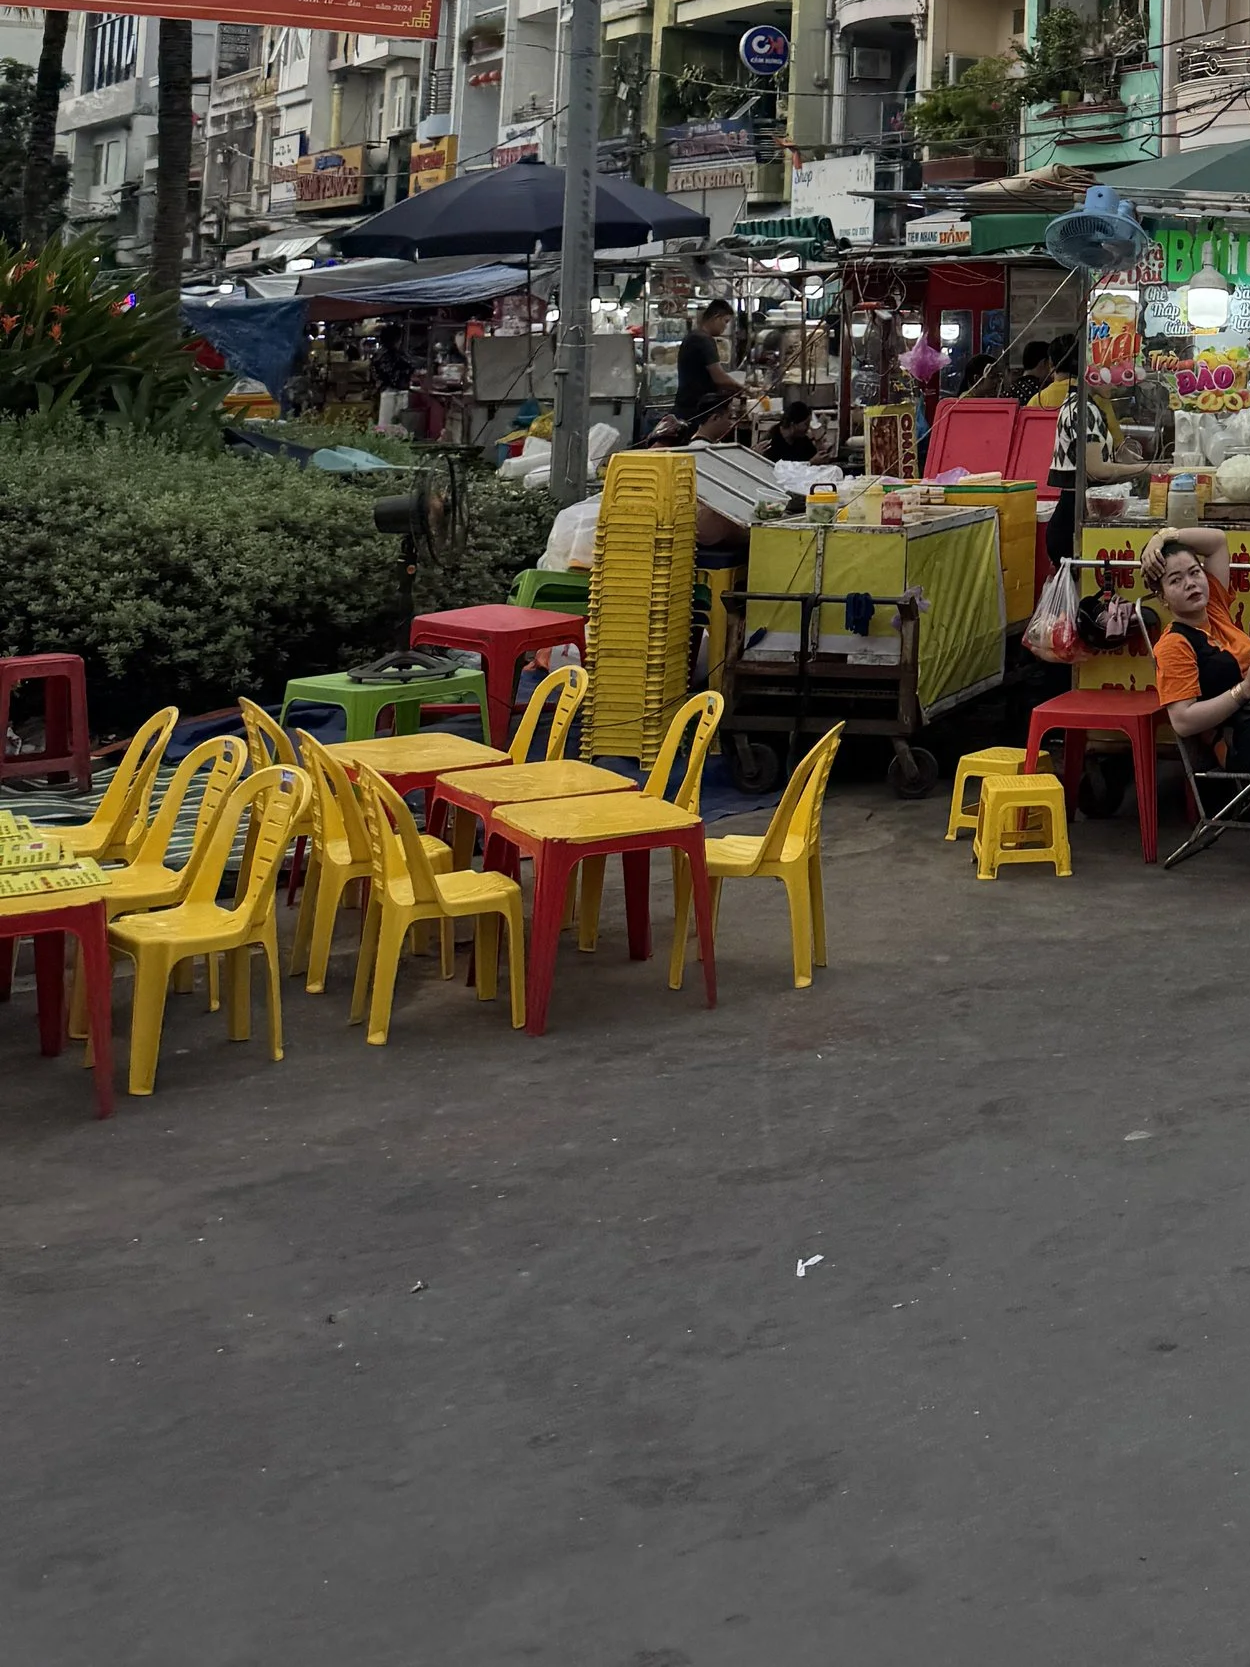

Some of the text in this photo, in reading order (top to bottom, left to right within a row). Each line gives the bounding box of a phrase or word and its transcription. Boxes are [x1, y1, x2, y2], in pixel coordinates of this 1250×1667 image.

[392, 4, 413, 13] 2024
[1152, 303, 1180, 321] Thập
[1091, 326, 1142, 366] VẢI
[1149, 349, 1180, 372] Trà
[1174, 360, 1236, 396] ĐÀO
[1094, 540, 1135, 589] CHÈ
